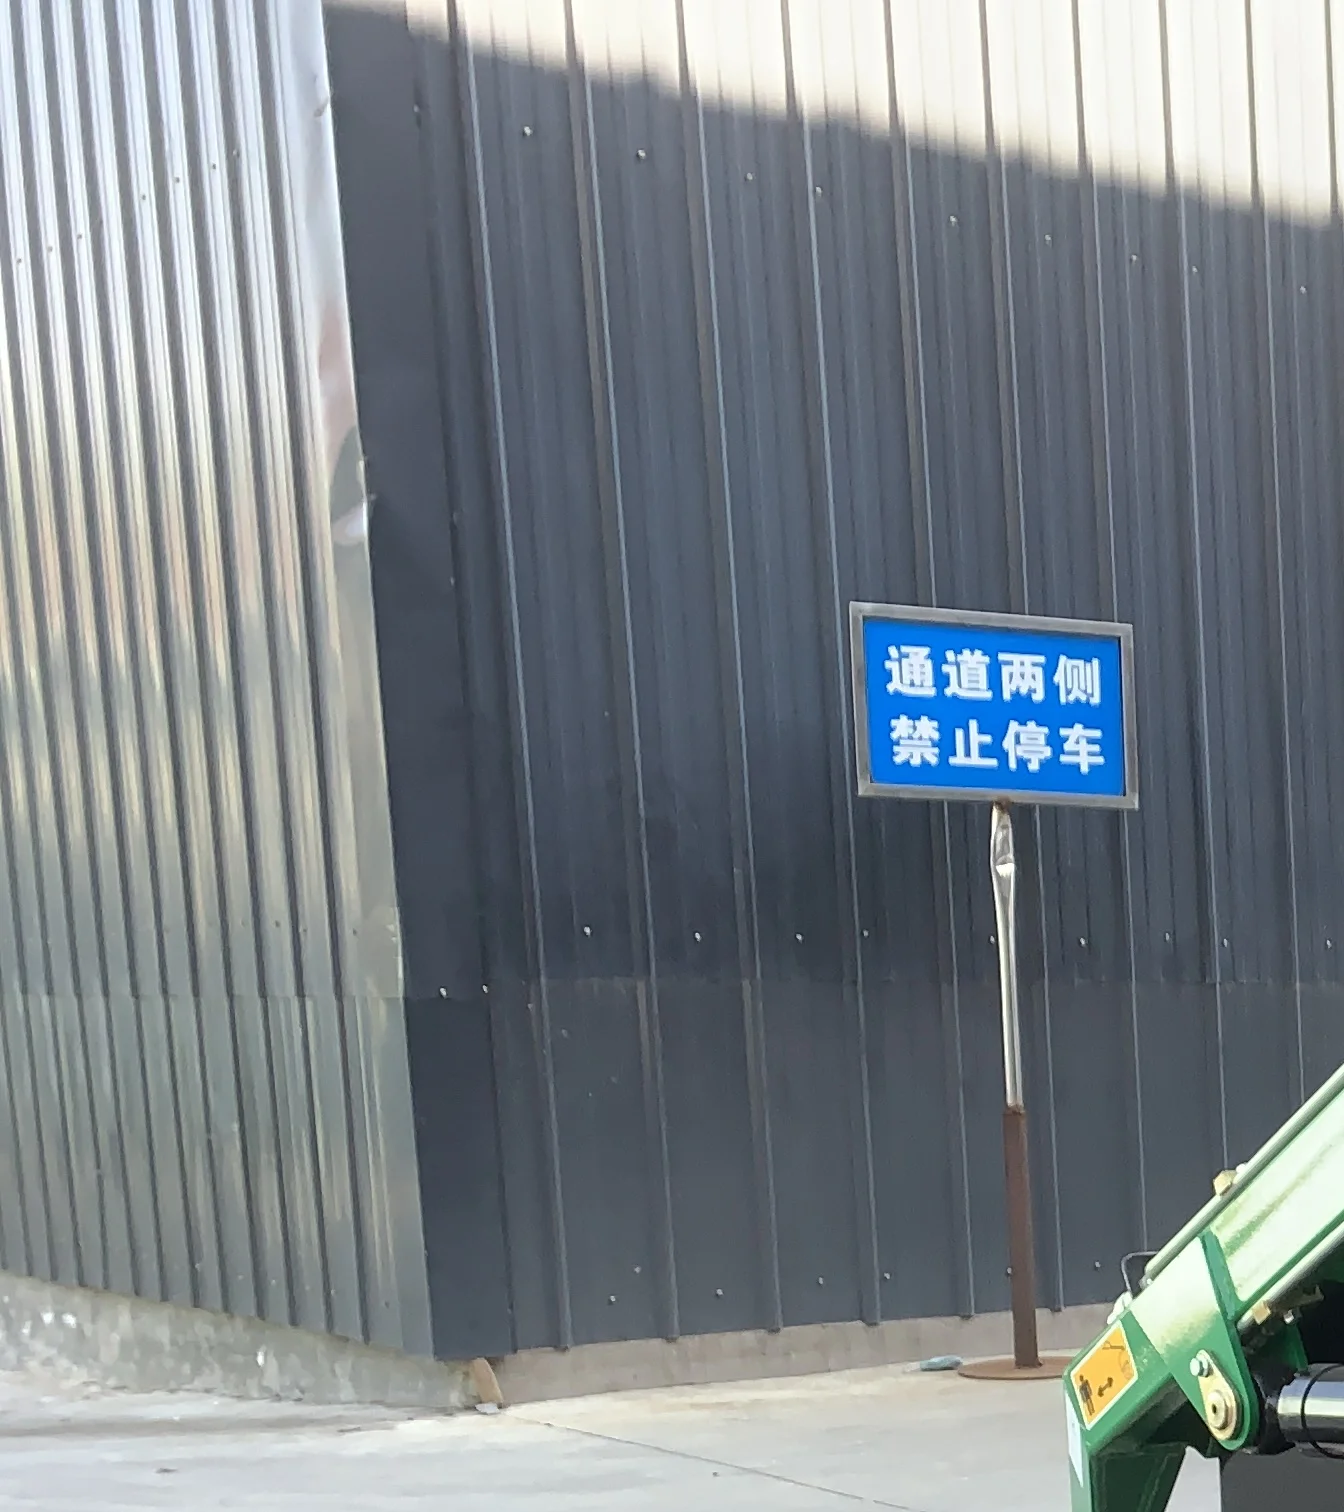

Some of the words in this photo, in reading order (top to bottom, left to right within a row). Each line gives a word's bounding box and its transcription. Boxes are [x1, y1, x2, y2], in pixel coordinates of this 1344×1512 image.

[884, 644, 1102, 706] 通道两侧
[890, 714, 1106, 775] 禁止停车
